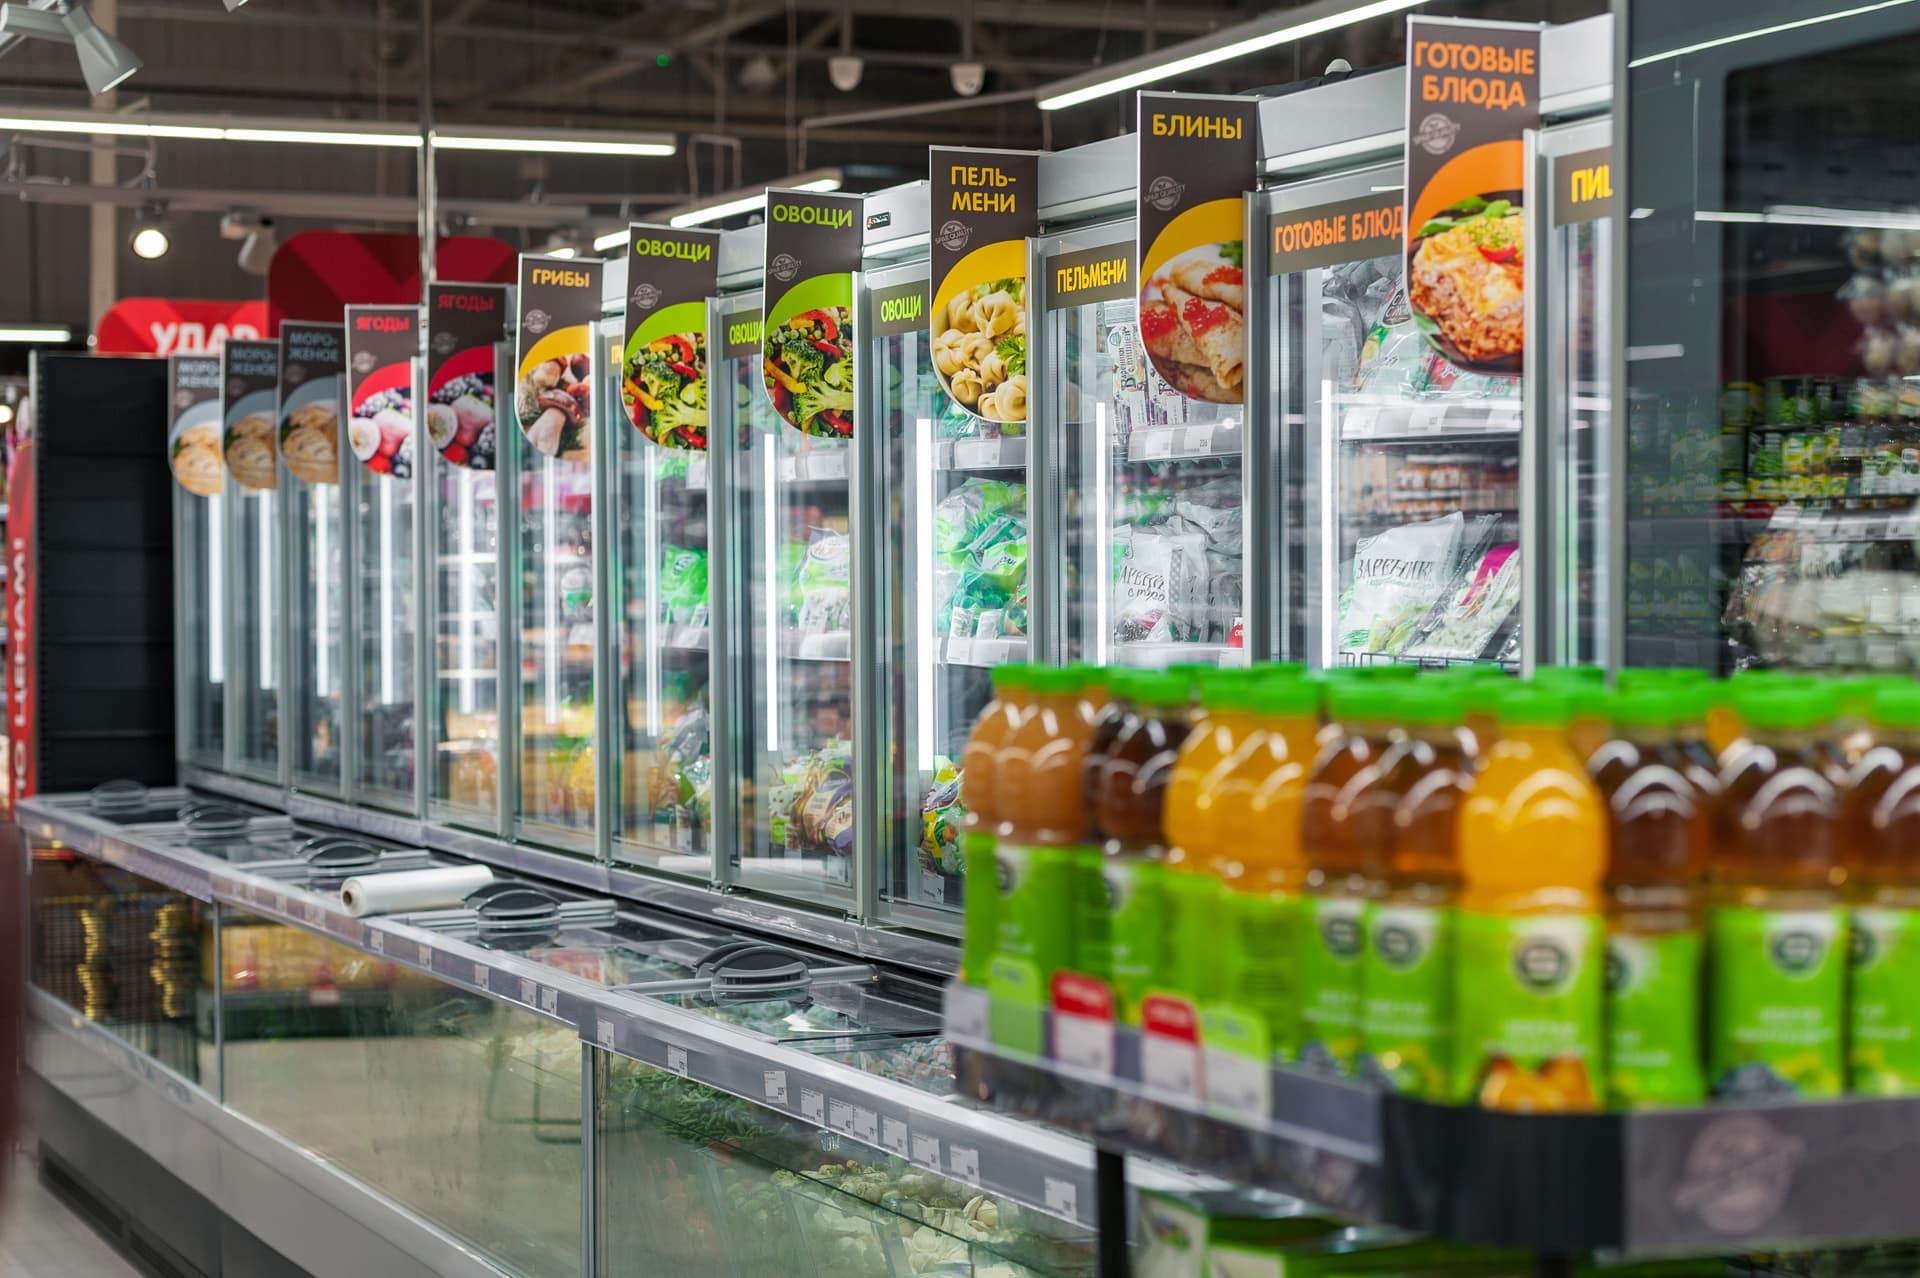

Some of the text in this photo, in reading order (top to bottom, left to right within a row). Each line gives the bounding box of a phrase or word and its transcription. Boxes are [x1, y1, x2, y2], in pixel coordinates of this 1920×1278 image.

[1414, 40, 1535, 75] ГОТОВЫЕ
[1422, 74, 1527, 111] БЛЮДА
[1152, 113, 1243, 140] БЛИНЫ
[950, 165, 1017, 188] ПЕЛЬ-
[951, 191, 1017, 214] МЕНИ
[771, 203, 853, 230] ОВОЩИ
[1273, 215, 1347, 254] ГОТОВЫЕ
[635, 238, 711, 263] ОВОЩИ
[531, 268, 591, 288] ГРИБЫ
[1056, 257, 1128, 294] ПЕЛЬМЕНИ
[437, 294, 495, 312] ЯГОДЫ
[880, 294, 922, 323] ОВОЩИ
[355, 316, 411, 333] ЯГОДЫ
